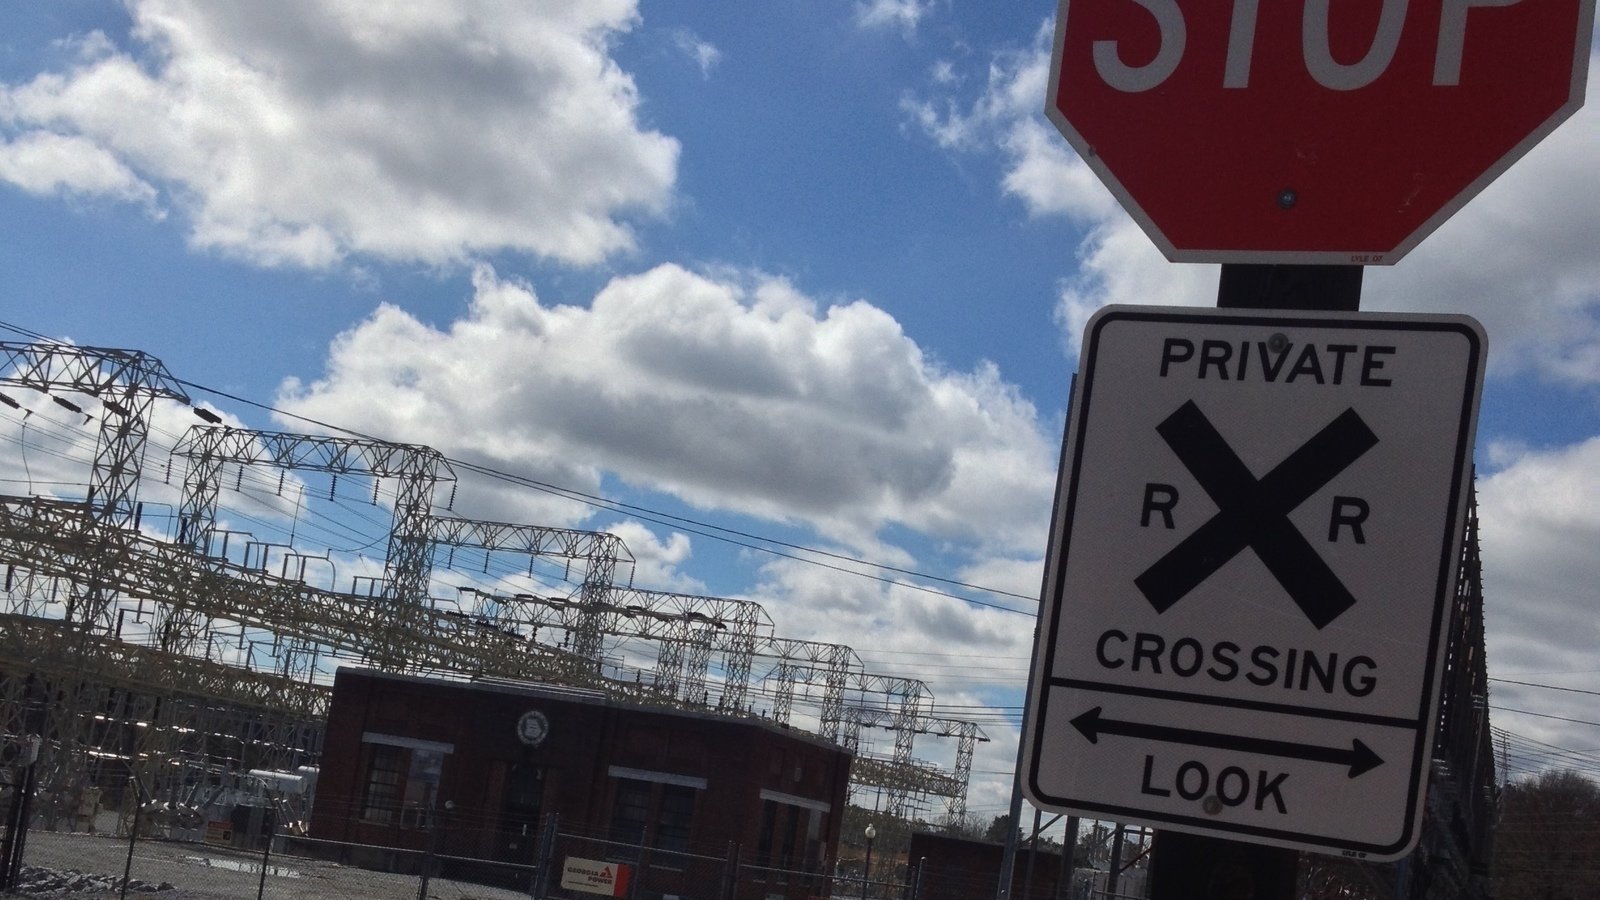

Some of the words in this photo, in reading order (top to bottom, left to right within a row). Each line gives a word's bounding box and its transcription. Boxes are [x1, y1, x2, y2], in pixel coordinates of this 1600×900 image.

[1160, 338, 1396, 387] PRIVATE
[1140, 483, 1179, 529] R
[1328, 495, 1370, 544] R
[1096, 629, 1378, 697] CROSSING
[1141, 754, 1290, 814] LOOK
[567, 866, 599, 877] GEORGIA
[587, 876, 613, 885] POWER
